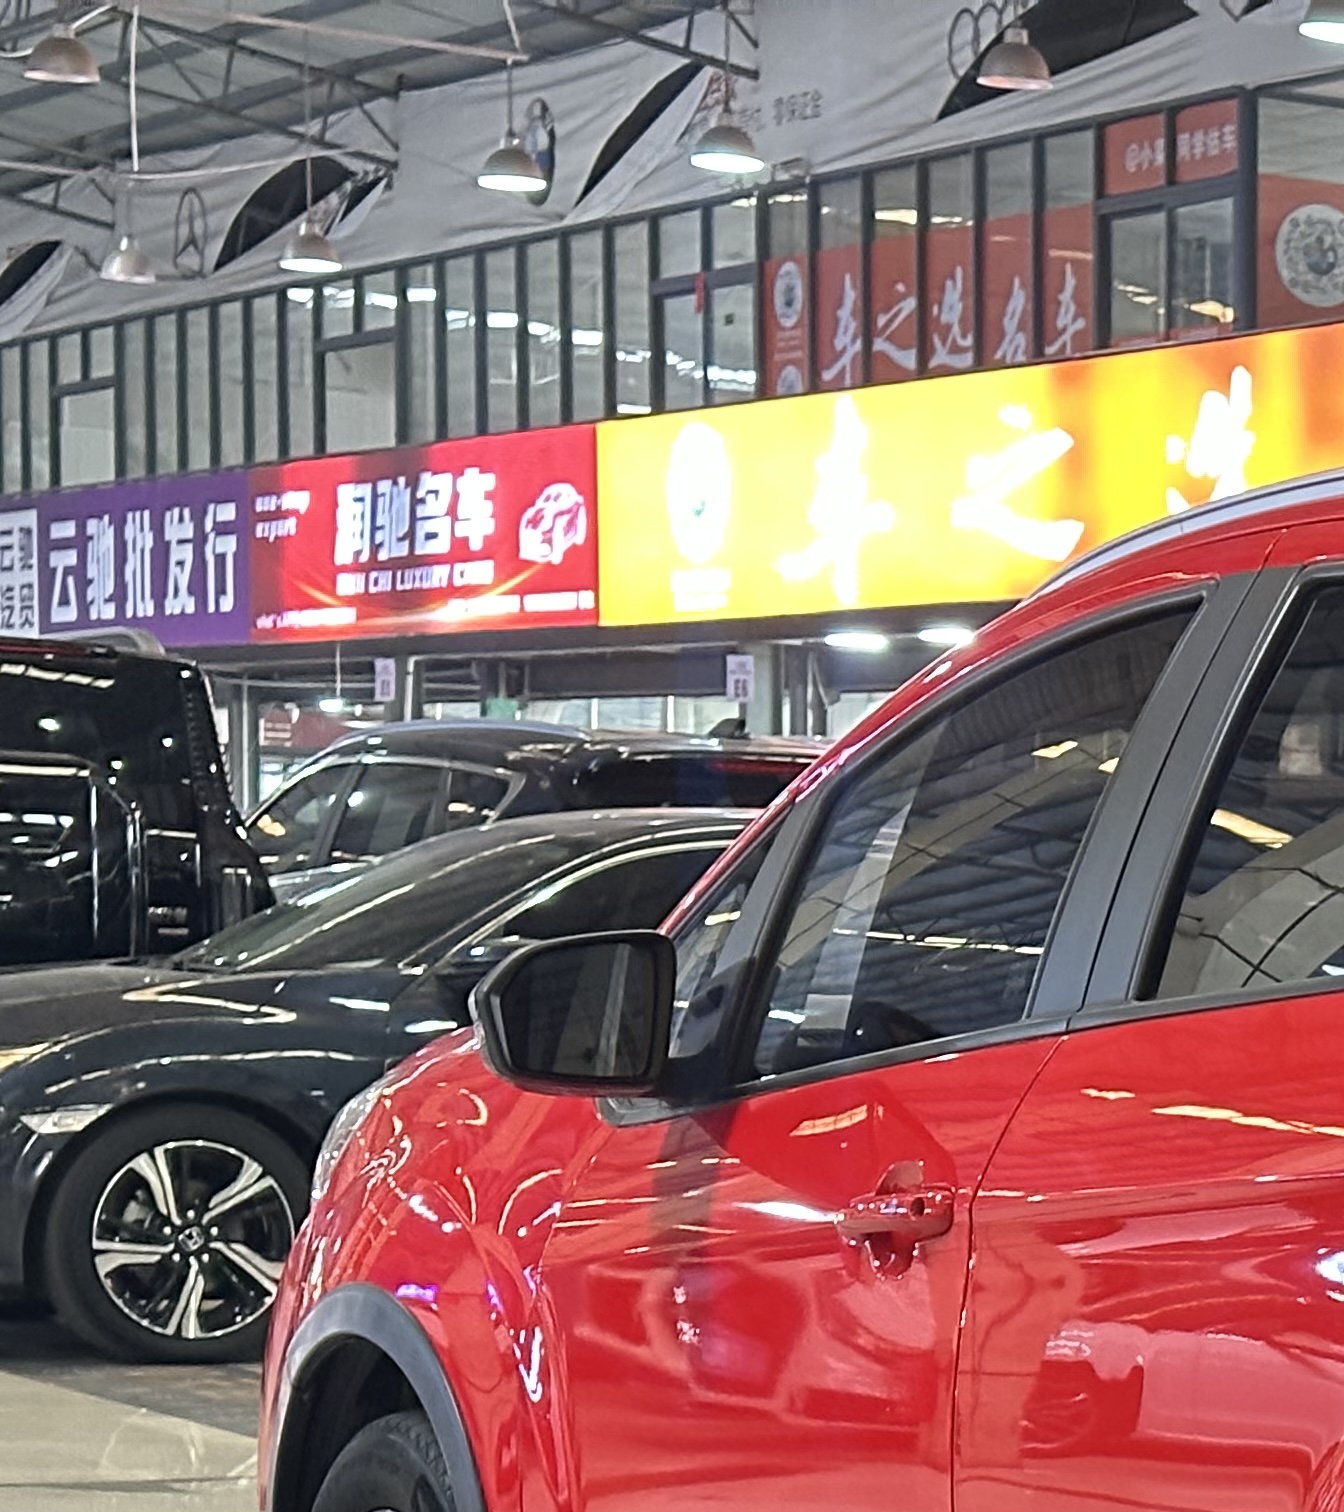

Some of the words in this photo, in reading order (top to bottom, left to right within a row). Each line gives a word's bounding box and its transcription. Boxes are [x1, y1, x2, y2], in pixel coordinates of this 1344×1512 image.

[821, 261, 1086, 387] 车之选名车
[49, 501, 237, 624] 云驰批发行
[368, 569, 392, 594] CHI
